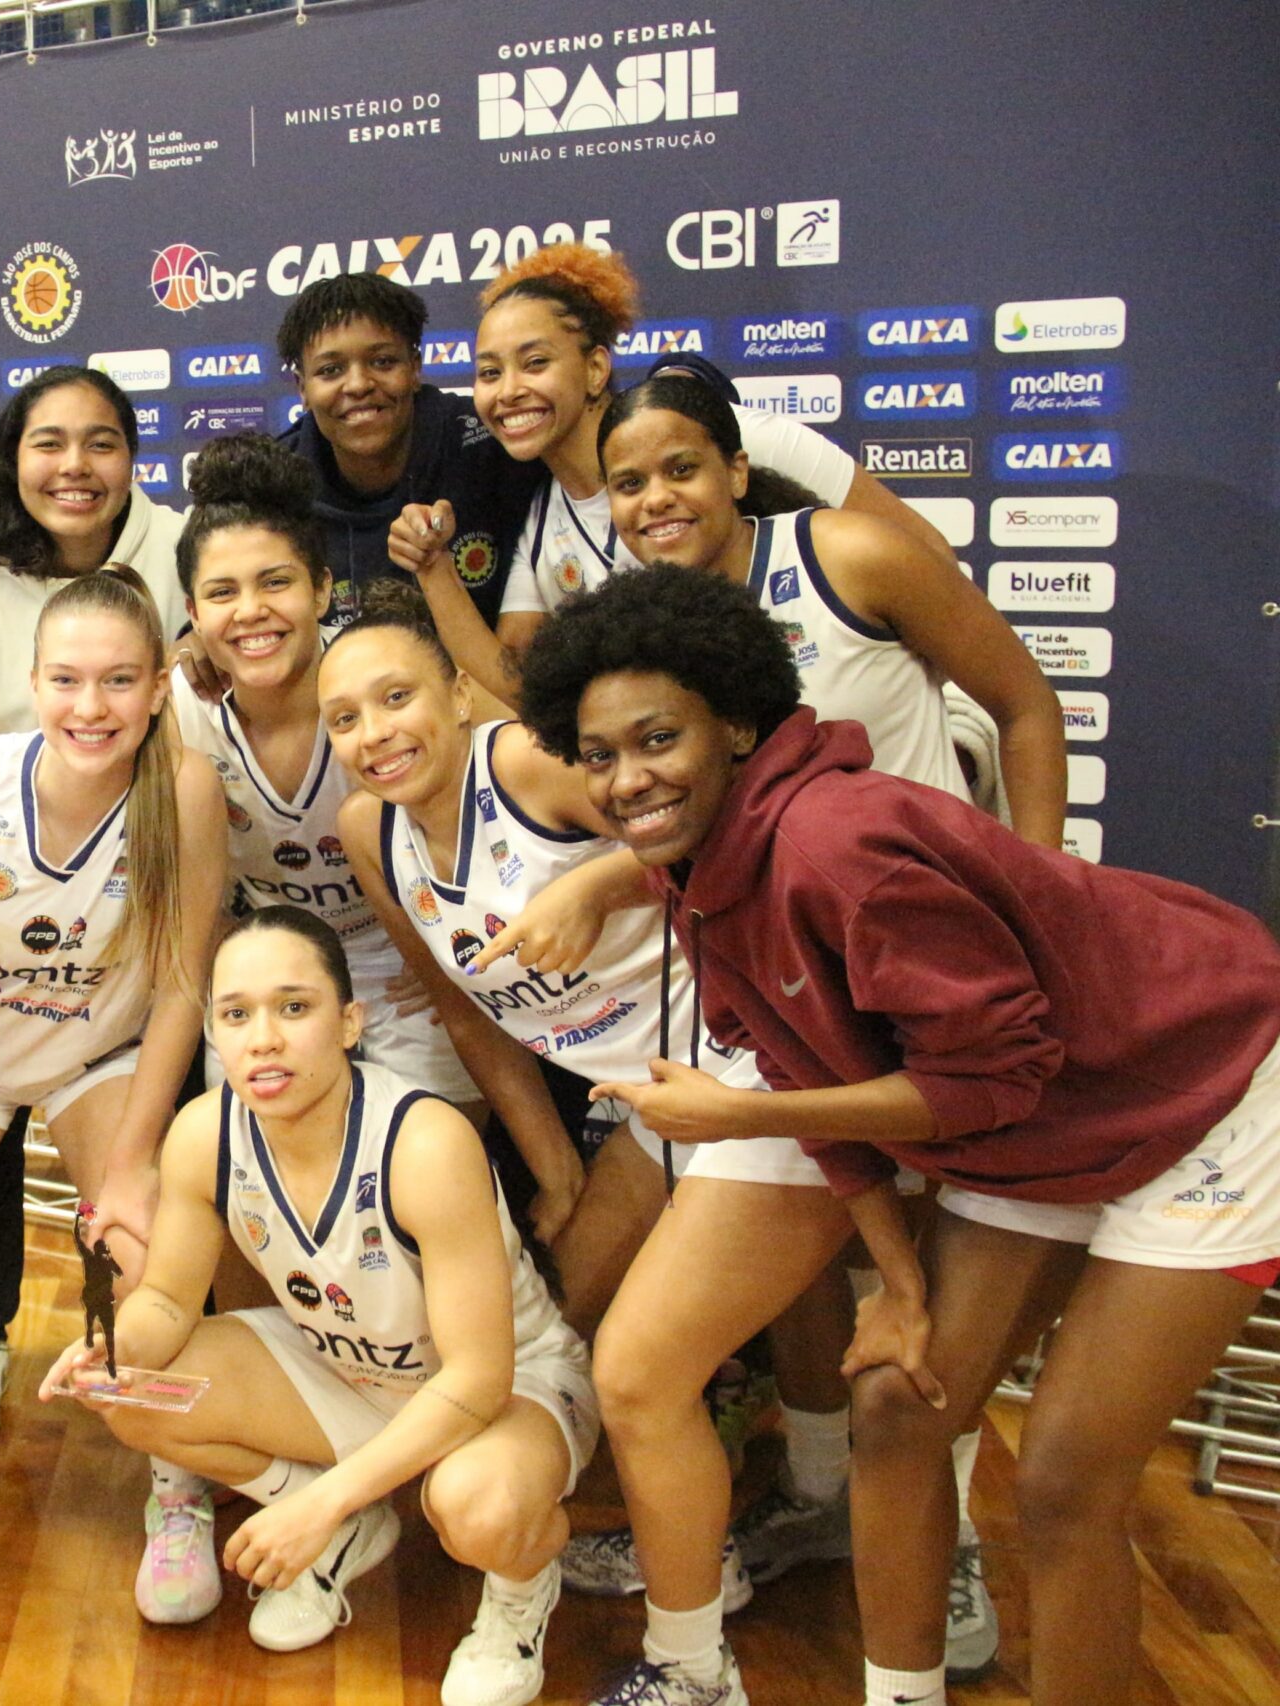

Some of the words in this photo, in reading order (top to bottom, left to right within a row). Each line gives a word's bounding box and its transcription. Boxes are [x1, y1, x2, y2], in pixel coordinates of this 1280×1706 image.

[498, 33, 603, 59] GOVERNO
[614, 19, 716, 45] FEDERAL
[478, 47, 738, 140] BRASIL
[285, 99, 402, 126] MINISTÉRIO
[412, 93, 440, 110] DO
[148, 131, 166, 144] Lei
[168, 130, 183, 142] de
[349, 118, 441, 143] ESPORTE
[149, 142, 201, 156] Incentivo
[203, 140, 219, 150] ao
[499, 146, 551, 164] UNIÃO
[559, 146, 567, 159] E
[576, 130, 716, 157] RECONSTRUÇÃO
[149, 156, 193, 171] Esporte
[13, 242, 33, 264] JOSÉ
[34, 242, 52, 253] DOS
[53, 245, 80, 279] CAMPOS
[267, 232, 462, 296] CAIXA
[1, 297, 51, 343] BASKETBALL
[50, 290, 82, 340] FEMININO
[614, 329, 703, 355] CAIXA
[743, 319, 826, 342] molten
[867, 318, 969, 345] CAIXA
[1033, 323, 1118, 339] Eletrobras
[112, 367, 166, 382] Eletrobras
[188, 354, 261, 378] CAIXA
[1011, 371, 1103, 394] molten
[864, 383, 965, 409] CAIXA
[865, 445, 967, 472] Renata
[1005, 443, 1112, 469] CAIXA
[1011, 572, 1091, 592] bluefit
[331, 614, 354, 627] SÃO
[798, 641, 817, 656] JOSÉ
[1037, 634, 1052, 643] Lei
[1055, 634, 1068, 643] de
[1036, 647, 1087, 657] Incentivo
[25, 932, 57, 940] FPB
[457, 942, 481, 962] FPB
[292, 1284, 318, 1298] FPB
